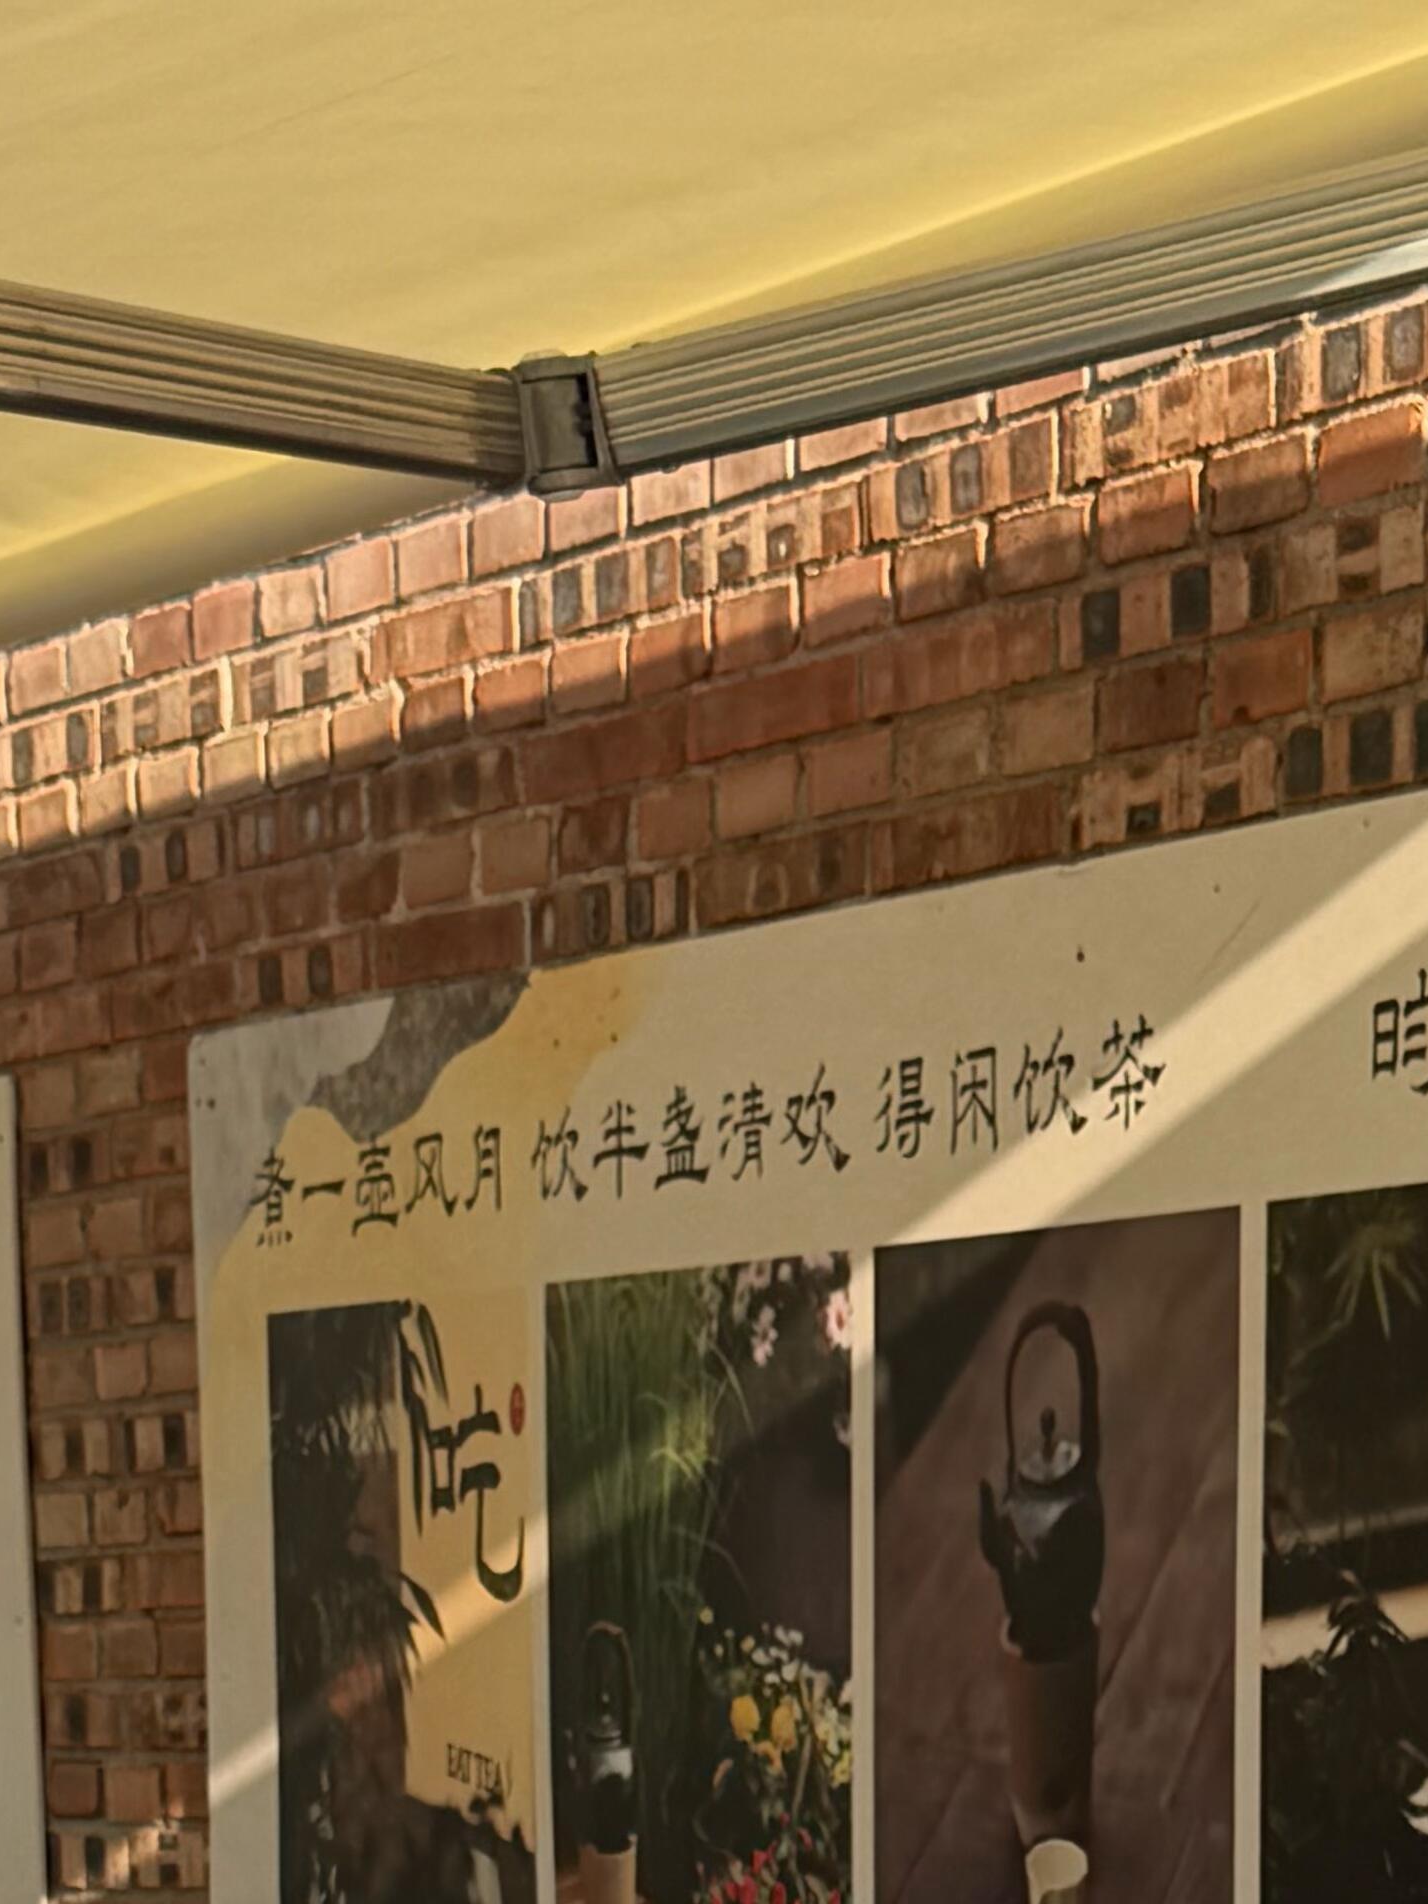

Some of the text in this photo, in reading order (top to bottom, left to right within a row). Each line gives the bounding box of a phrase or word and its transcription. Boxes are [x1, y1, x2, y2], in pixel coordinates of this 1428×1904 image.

[248, 1014, 1167, 1247] 煮一壶风月 饮半盏清欢 得闲饮茶
[446, 1742, 472, 1785] EAT
